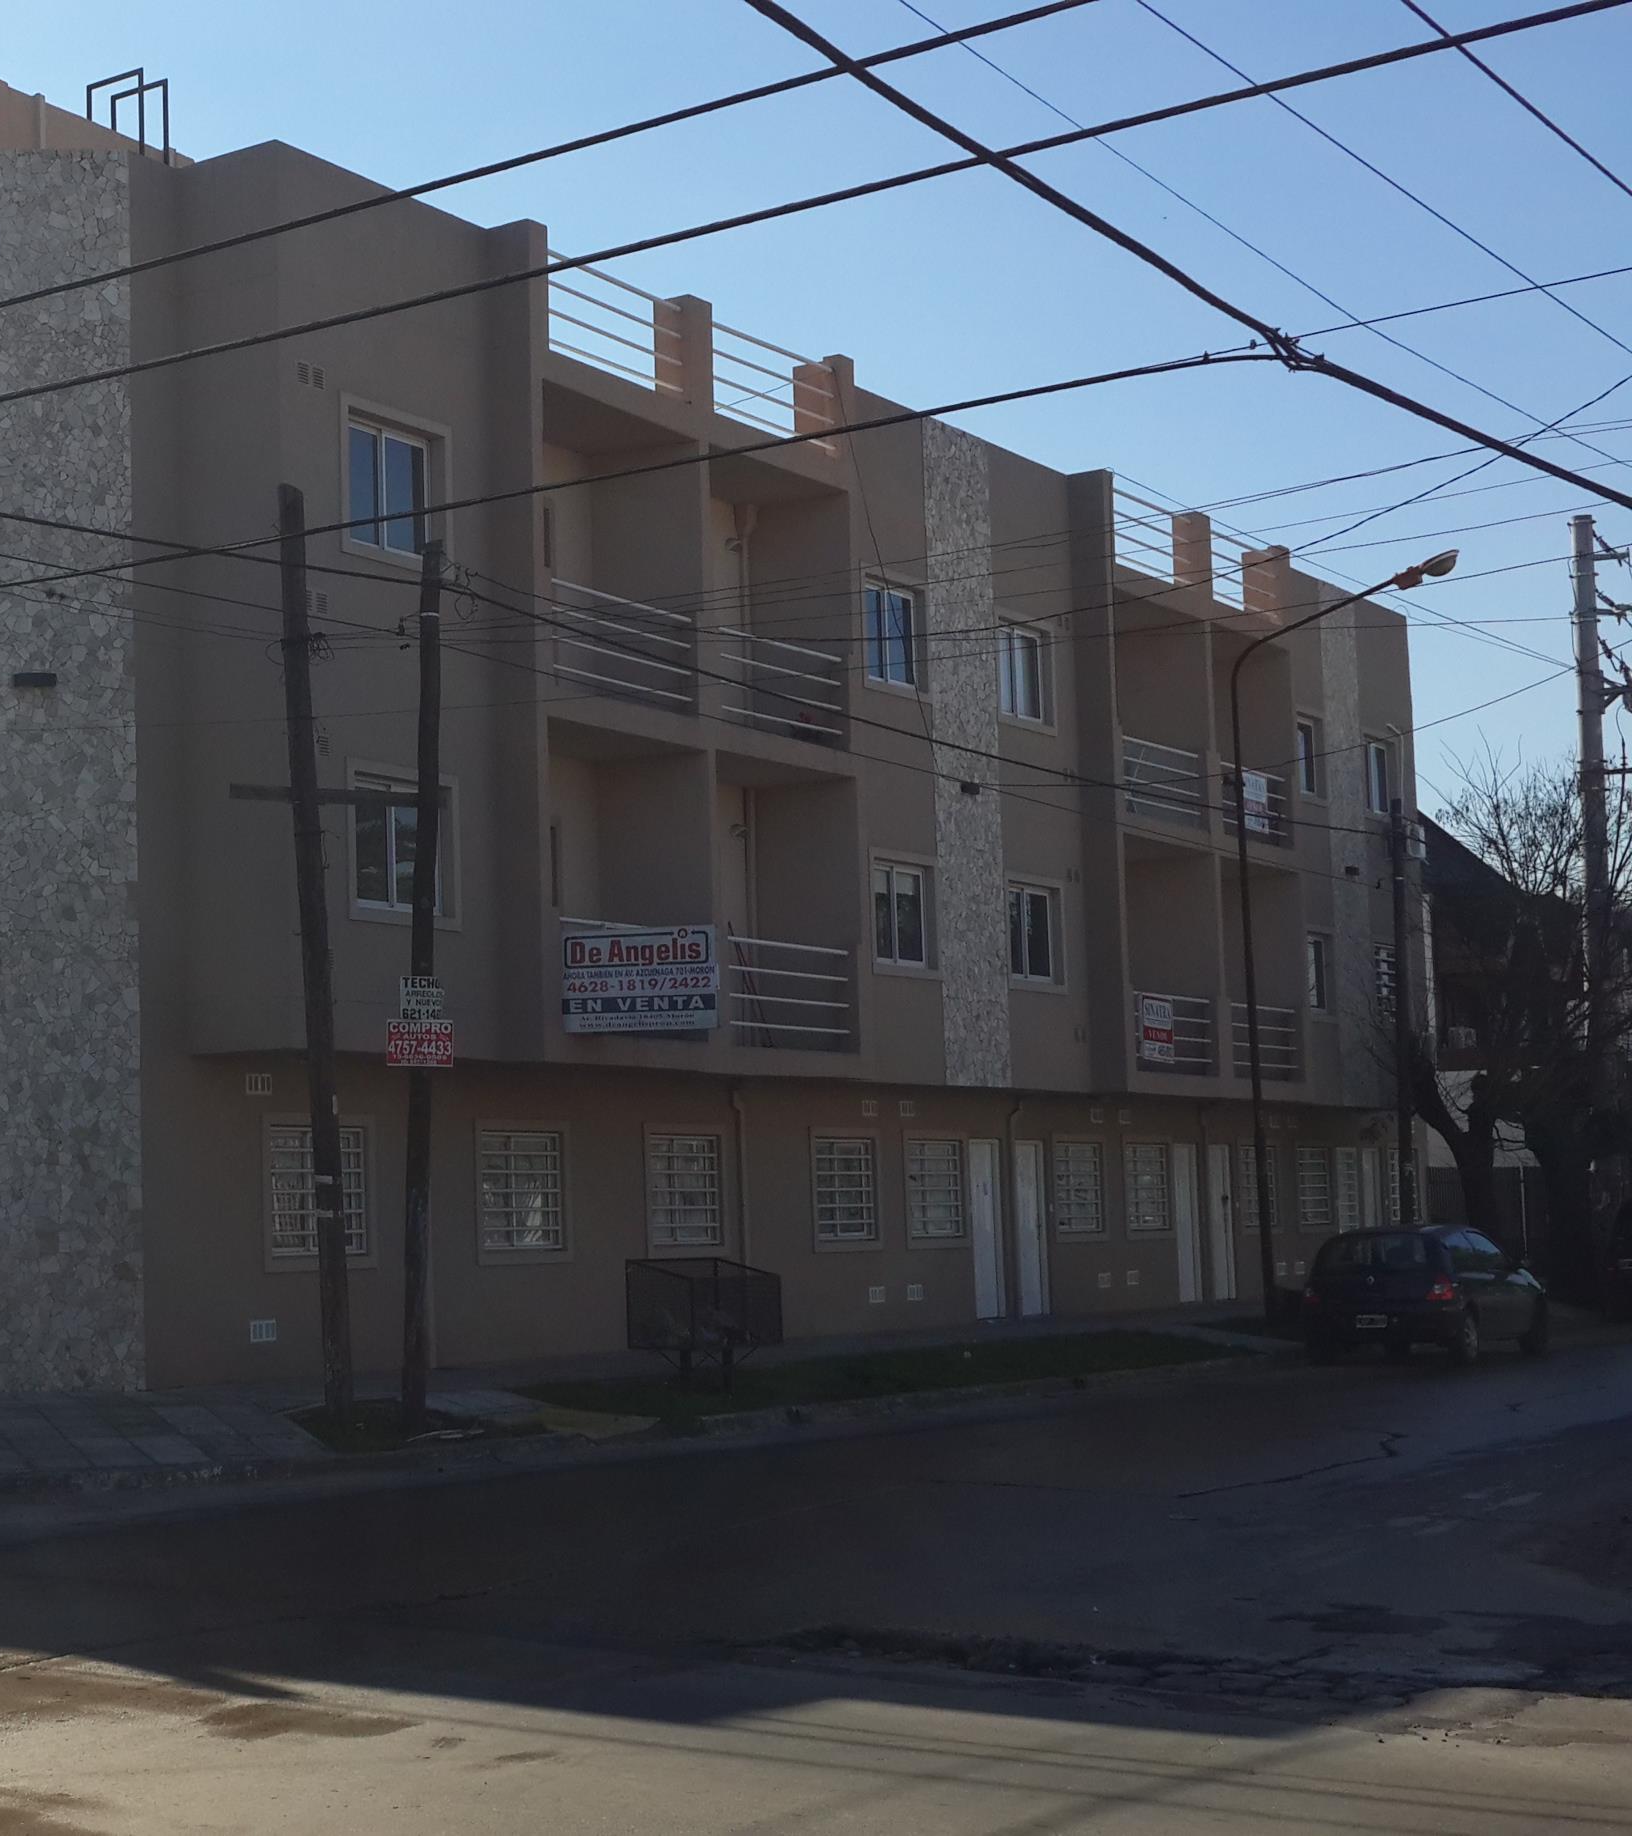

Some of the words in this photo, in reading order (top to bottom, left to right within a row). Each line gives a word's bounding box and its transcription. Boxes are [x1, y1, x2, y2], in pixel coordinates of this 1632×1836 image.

[570, 941, 602, 965] De
[608, 937, 701, 966] Angelis
[568, 976, 712, 993] 4628-1819/2422
[570, 998, 603, 1013] EN
[617, 995, 705, 1011] VENTA
[389, 1022, 452, 1034] COMPRO
[388, 1040, 452, 1055] 4757-4433
